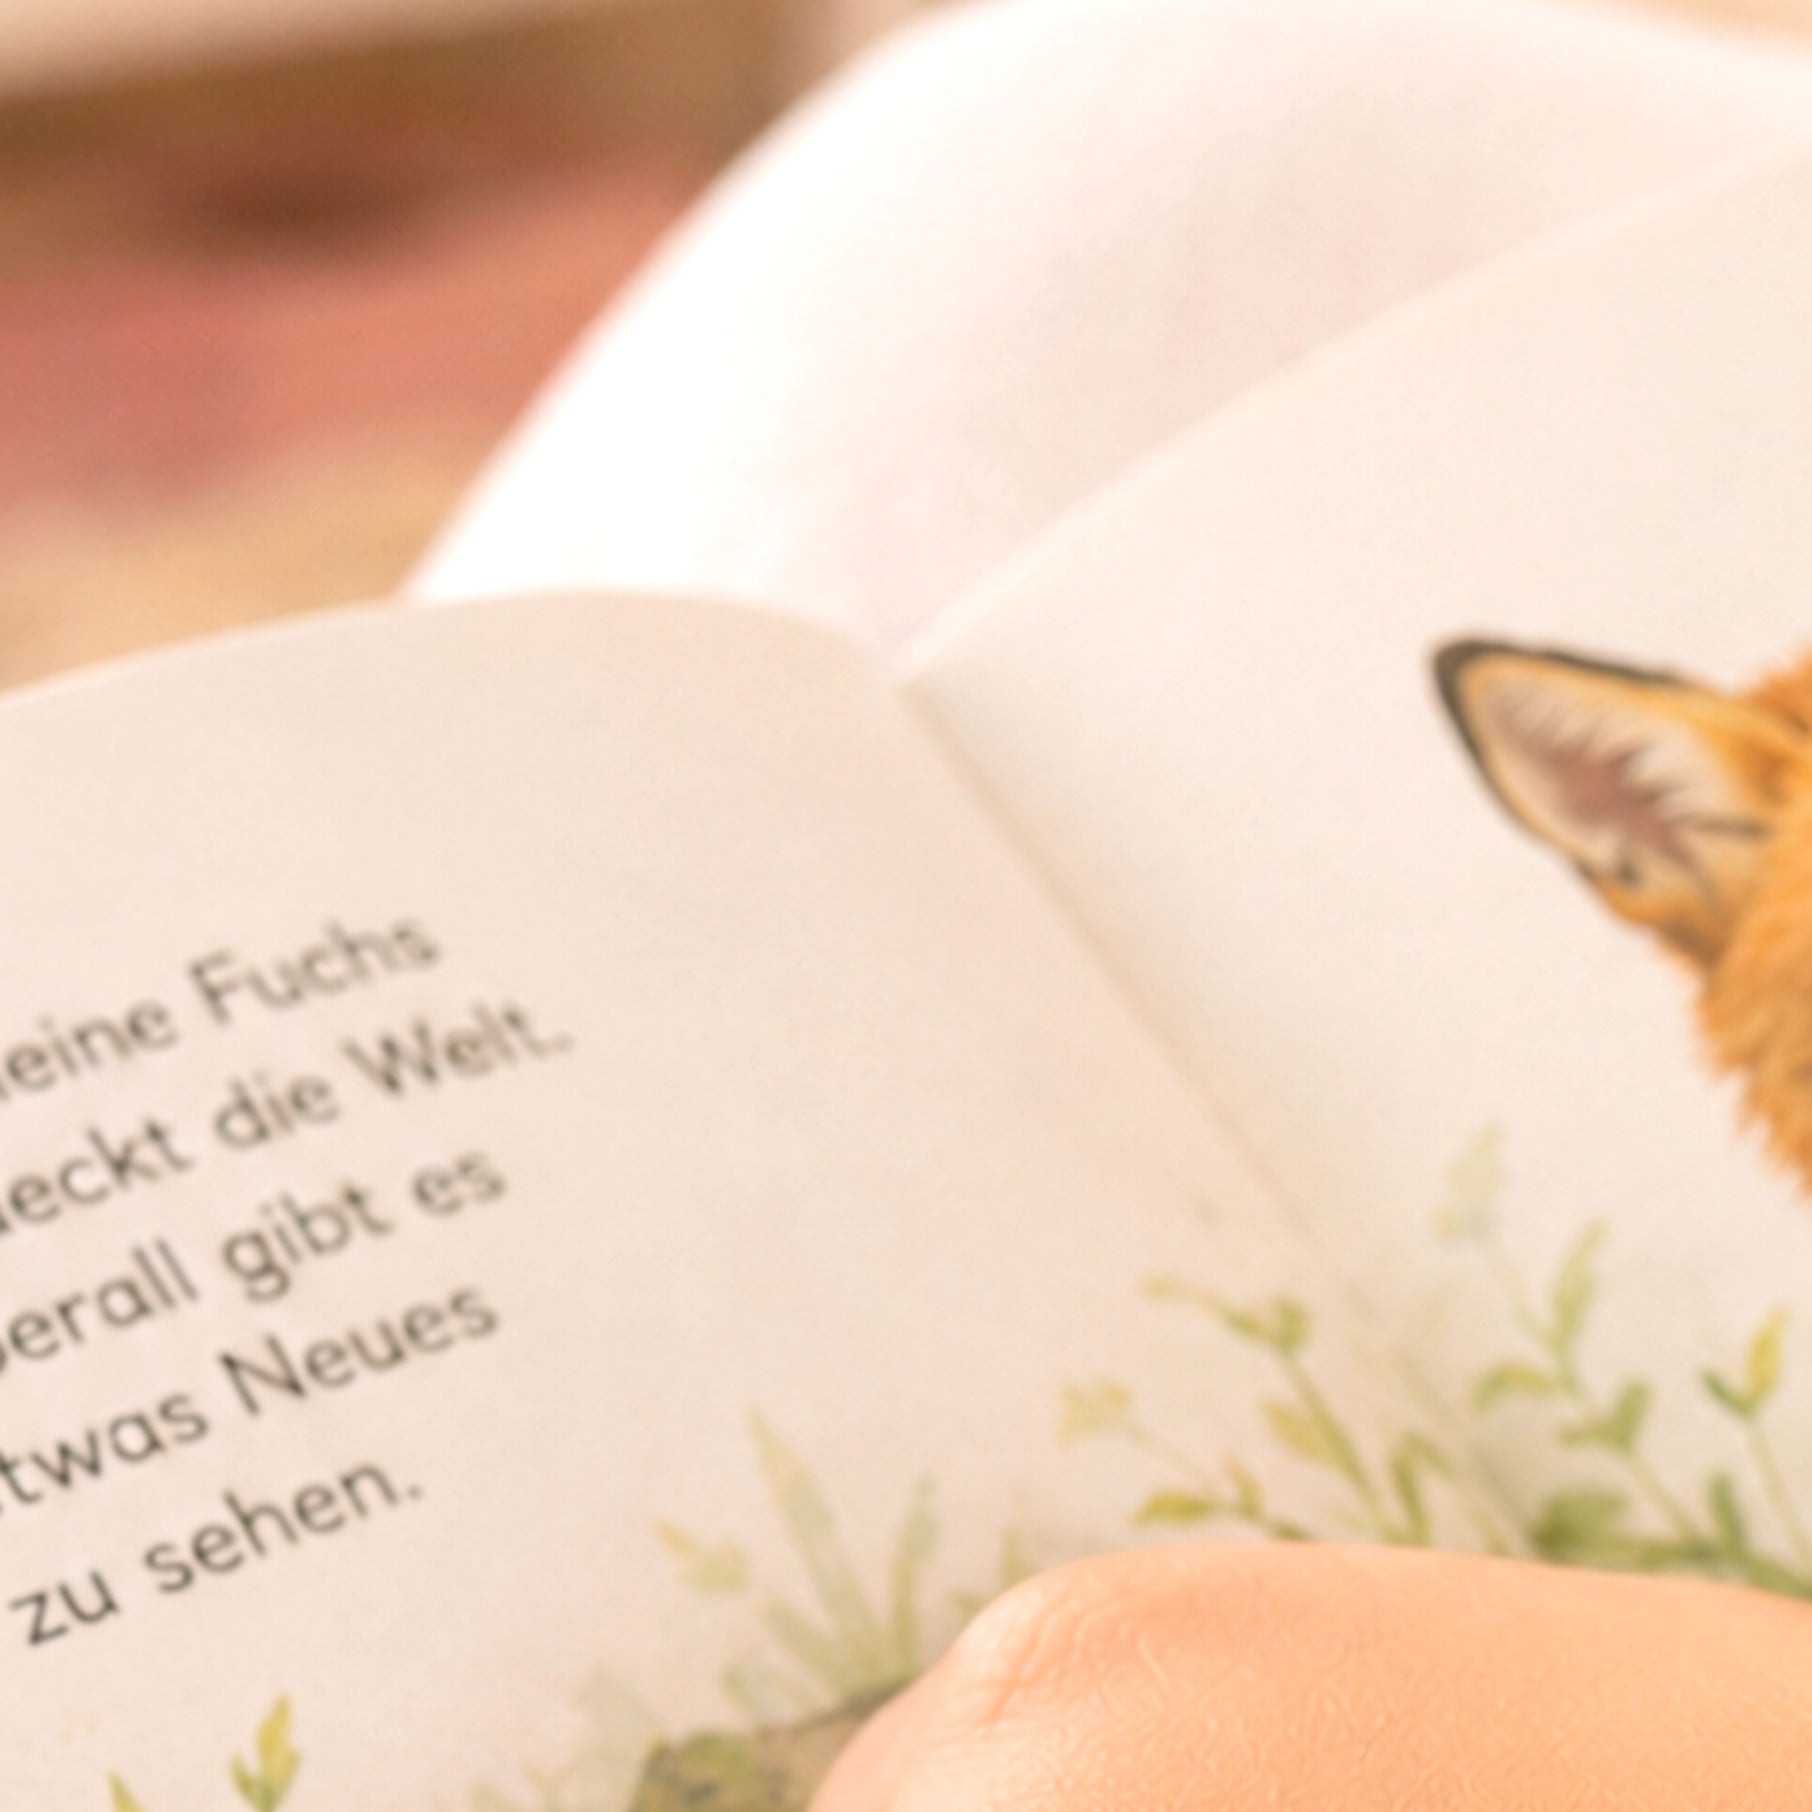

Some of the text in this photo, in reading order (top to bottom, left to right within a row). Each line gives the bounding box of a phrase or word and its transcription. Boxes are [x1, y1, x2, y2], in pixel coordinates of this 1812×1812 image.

[0, 918, 442, 1102] eine Fuchs
[0, 1000, 574, 1239] eckt die Welt.
[0, 1152, 508, 1377] erall gibt es
[0, 1287, 500, 1508] twas Neues
[8, 1462, 424, 1649] zu sehen.
